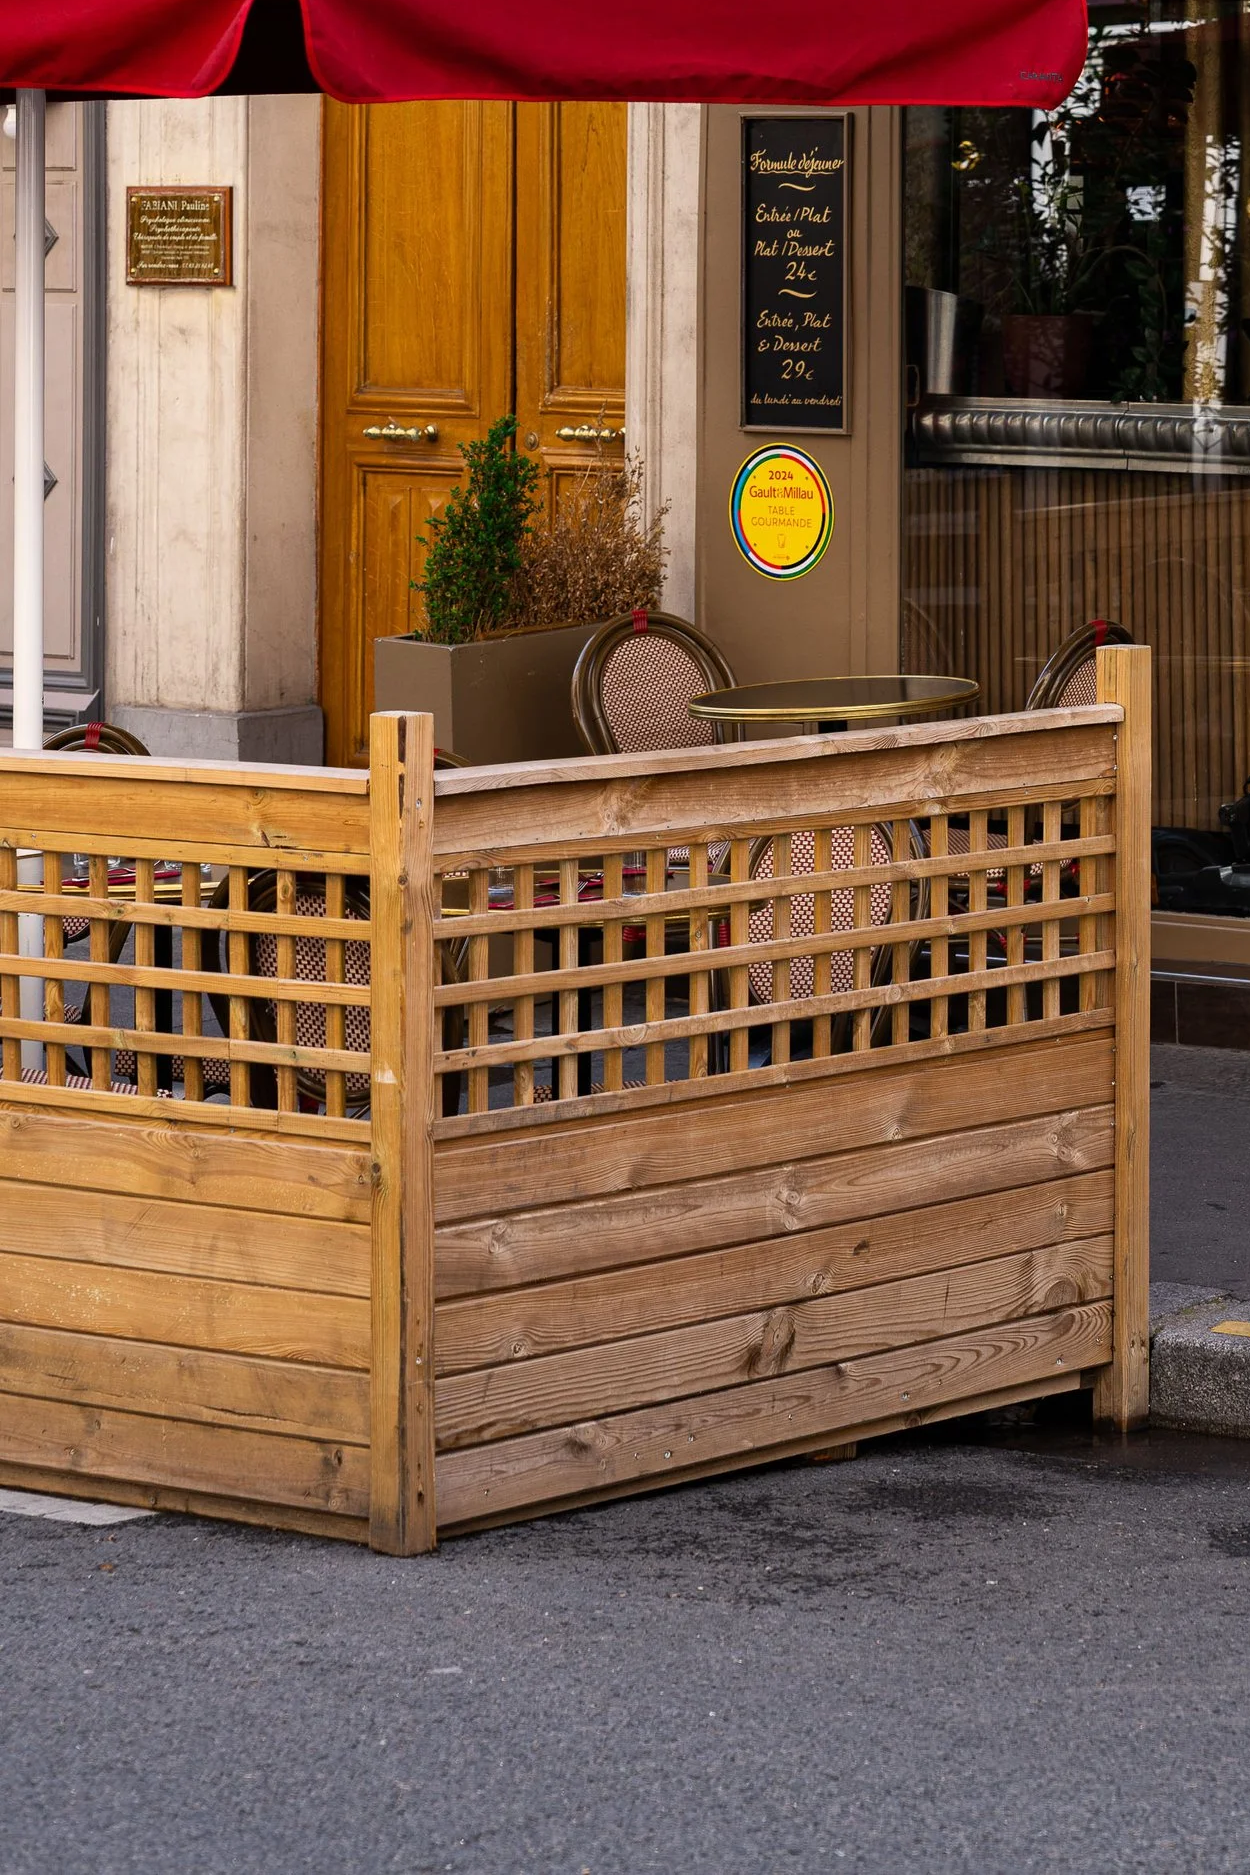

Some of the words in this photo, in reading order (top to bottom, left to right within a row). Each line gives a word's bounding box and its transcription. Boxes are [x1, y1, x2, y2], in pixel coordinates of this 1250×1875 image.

[750, 148, 797, 171] Formule
[798, 146, 844, 178] déjeuner
[786, 228, 803, 238] ou
[801, 311, 832, 328] Plat
[773, 335, 822, 352] Dessert
[768, 470, 794, 481] 2024
[768, 505, 795, 516] TABLE
[751, 516, 812, 529] GOURMANDE
